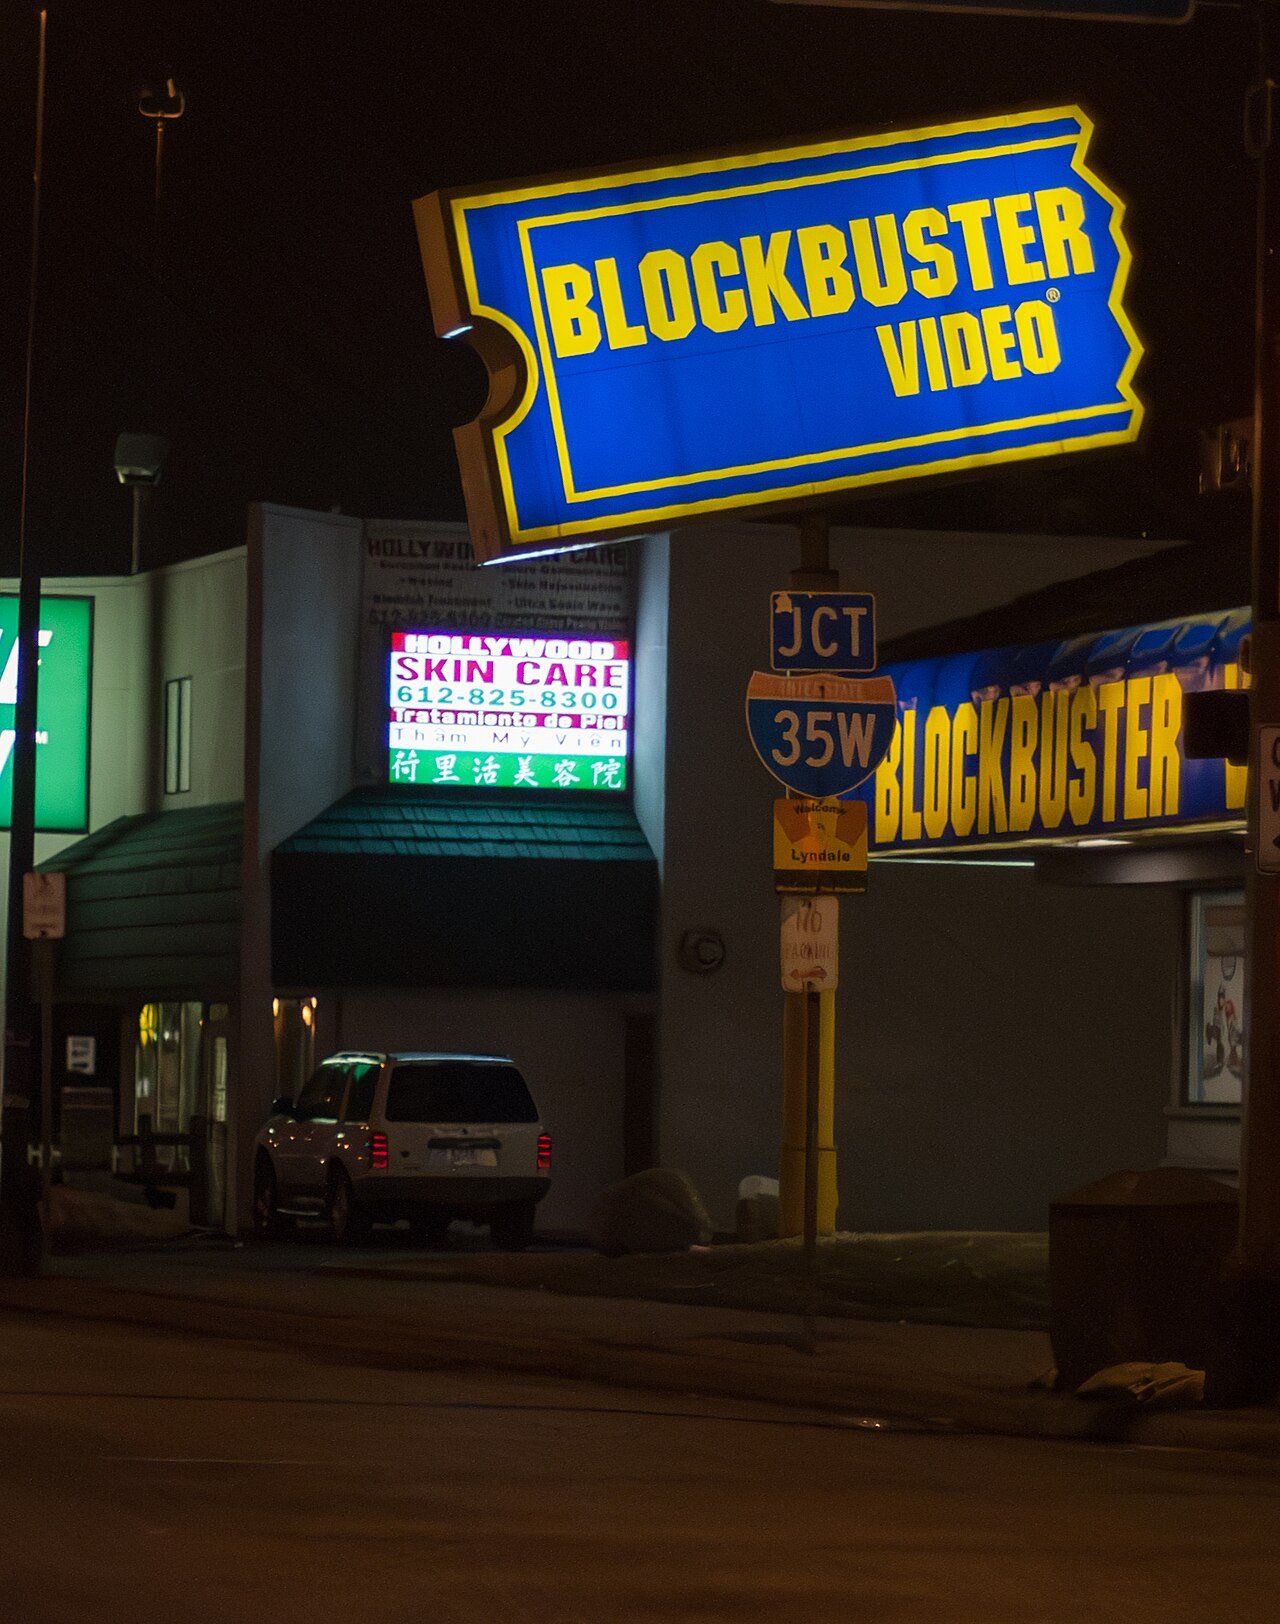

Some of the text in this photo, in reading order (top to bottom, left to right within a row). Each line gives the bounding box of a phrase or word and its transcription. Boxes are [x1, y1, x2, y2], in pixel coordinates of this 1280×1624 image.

[541, 187, 1095, 359] BLOCKBUSTER
[875, 300, 1062, 398] VIDEO
[405, 634, 615, 660] HOLLYWOOD
[777, 606, 868, 657] JCT
[396, 656, 623, 688] SKIN CARE
[397, 685, 618, 710] 612-825-8300
[393, 707, 624, 730] Tratamiento de Piel
[771, 709, 876, 769] 35W
[875, 672, 1183, 844] BLOCKBUSTER
[791, 848, 851, 864] Lyndale
